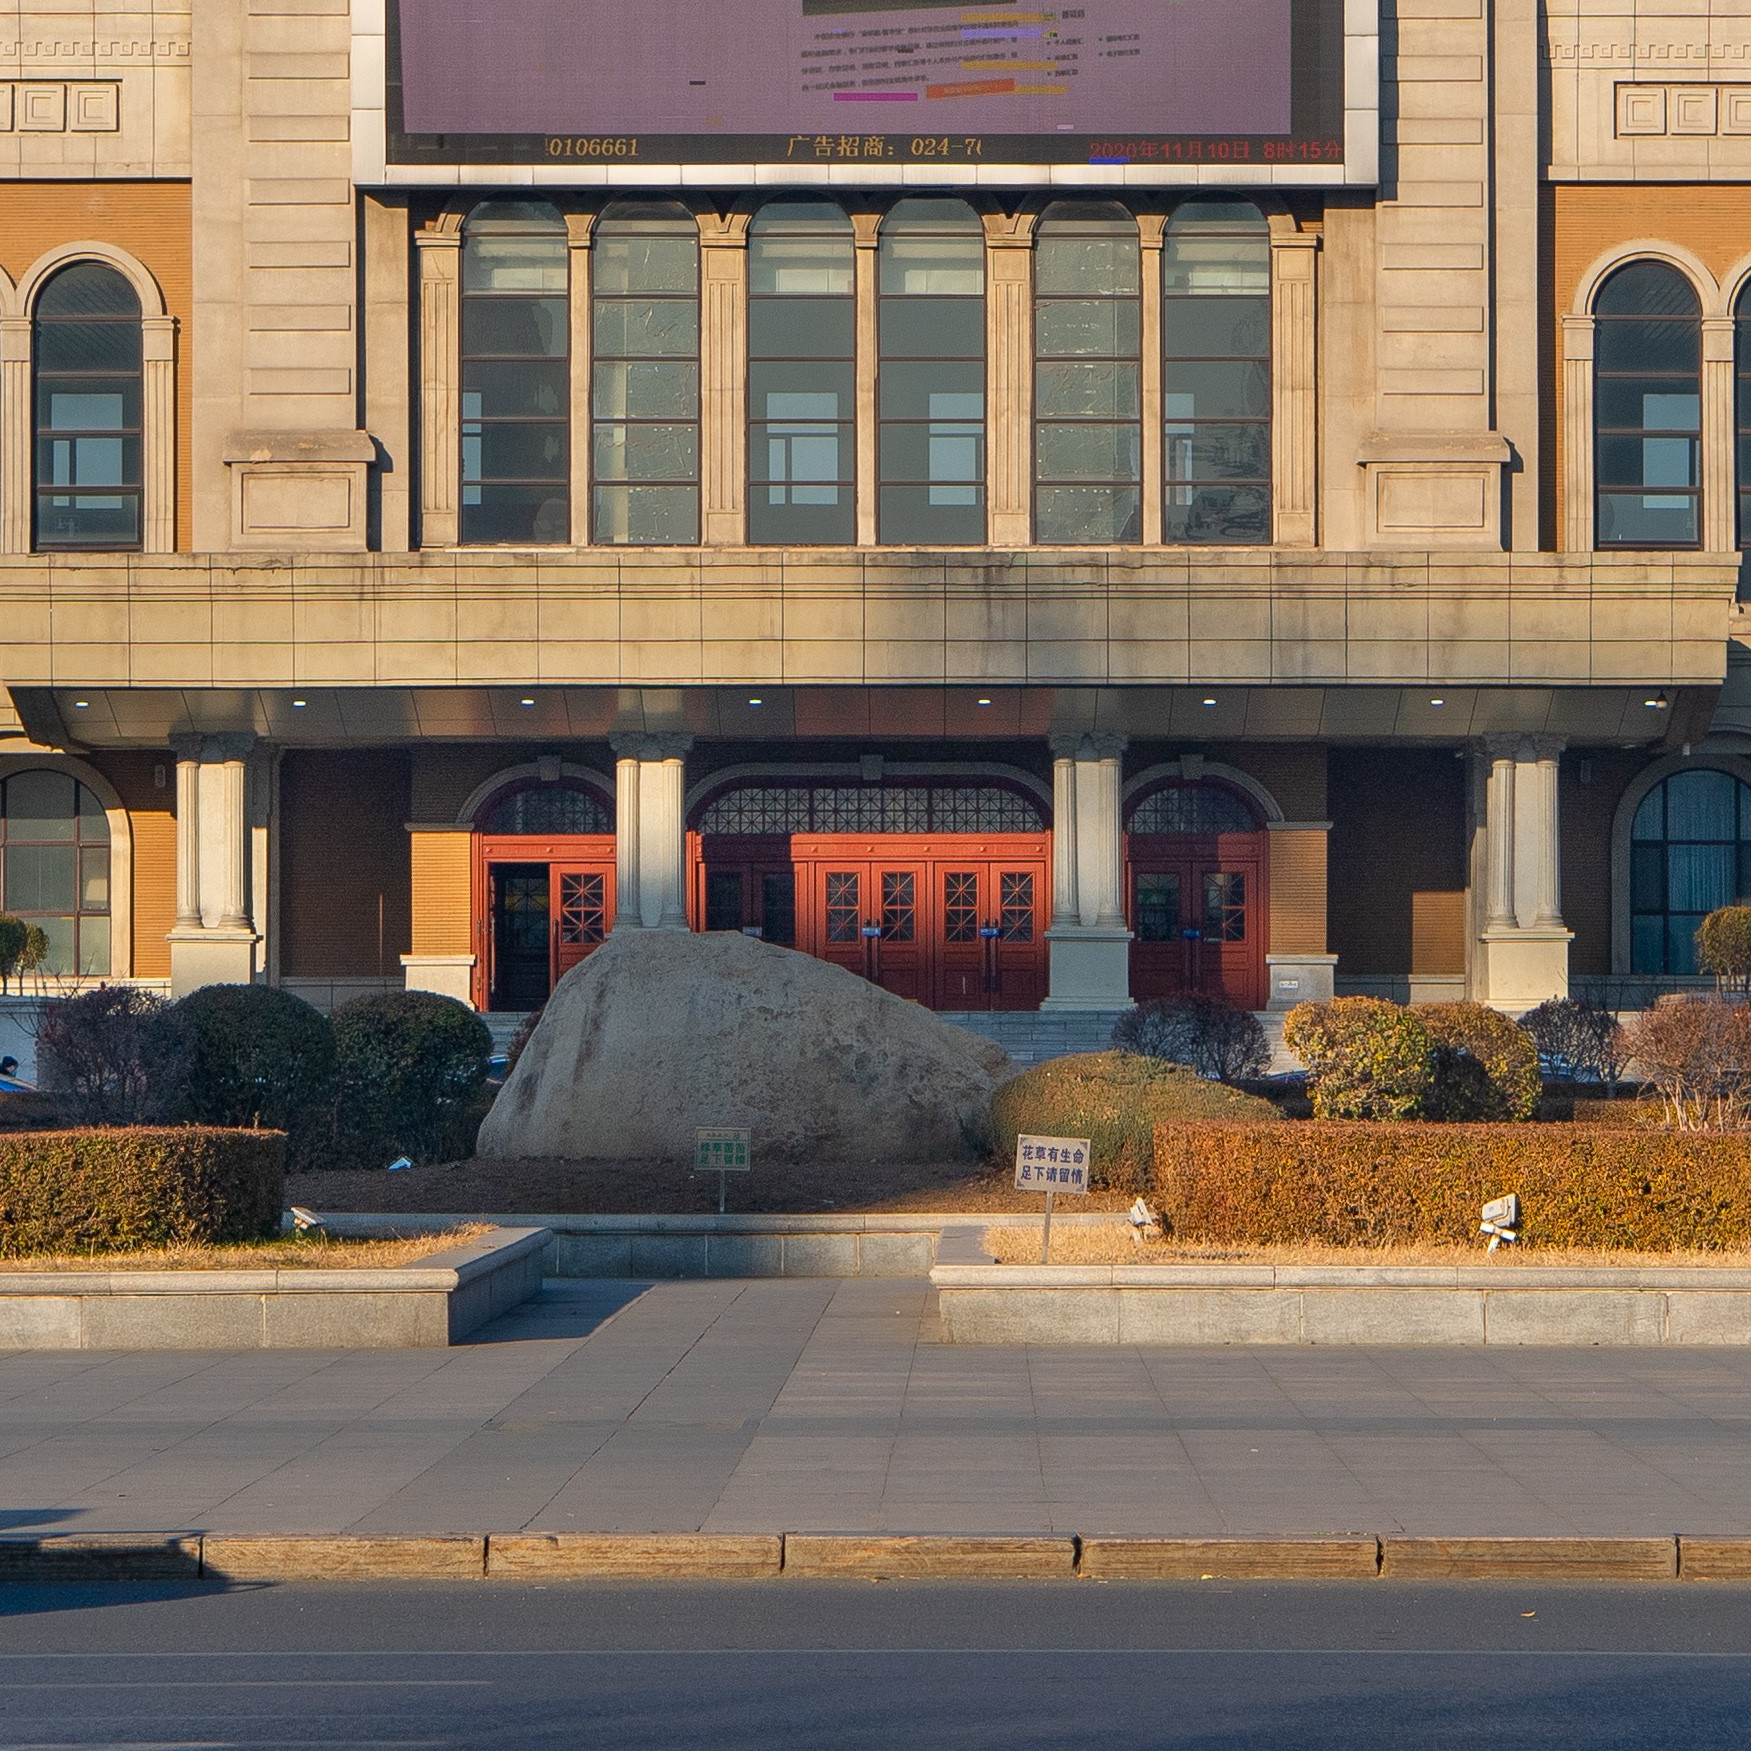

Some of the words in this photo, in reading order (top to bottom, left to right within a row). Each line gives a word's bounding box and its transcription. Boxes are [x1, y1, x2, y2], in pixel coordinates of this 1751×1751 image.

[544, 137, 638, 156] 0106661
[1022, 1144, 1085, 1164] 花草有生命
[1020, 1164, 1083, 1184] 足下请留情
